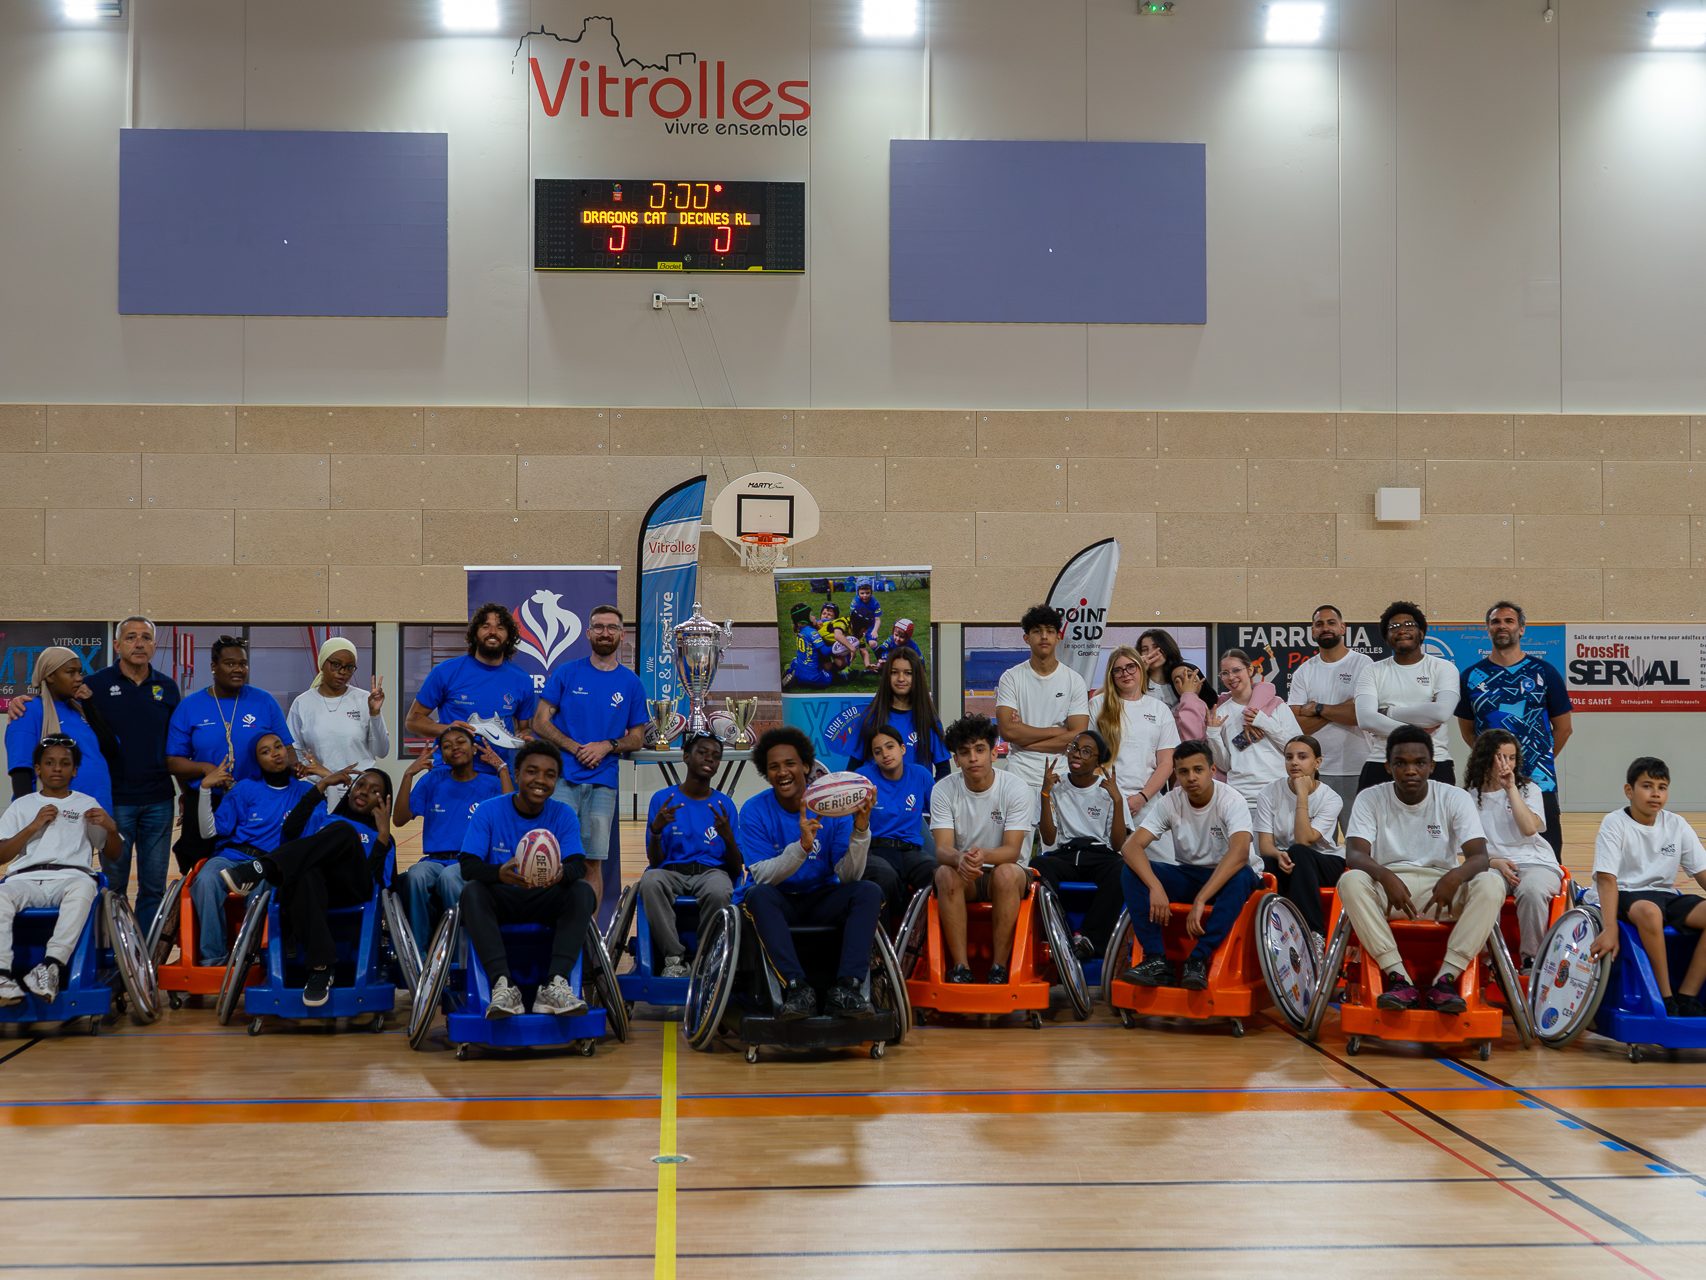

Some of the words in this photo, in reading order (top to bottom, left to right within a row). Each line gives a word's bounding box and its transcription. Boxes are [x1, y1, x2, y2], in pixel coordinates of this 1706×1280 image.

[528, 57, 811, 121] Vitrolles
[665, 118, 709, 136] vivre
[715, 119, 808, 137] ensemble
[583, 211, 638, 225] DRAGONS
[644, 211, 667, 225] CAT
[680, 212, 730, 225] DECINES
[735, 213, 751, 226] RL
[659, 262, 682, 270] Bodet
[649, 540, 696, 554] Vitrolles
[1072, 625, 1104, 641] SUD
[1238, 626, 1372, 648] FARRUIA
[53, 637, 102, 646] VITROLLES
[1350, 646, 1383, 654] TROLLES
[1576, 643, 1630, 659] CrossFit
[646, 656, 654, 673] Ville
[1568, 659, 1690, 687] SERVAL
[1588, 697, 1612, 705] SANTÉ
[824, 717, 844, 740] LIGUE
[842, 706, 858, 720] SUD
